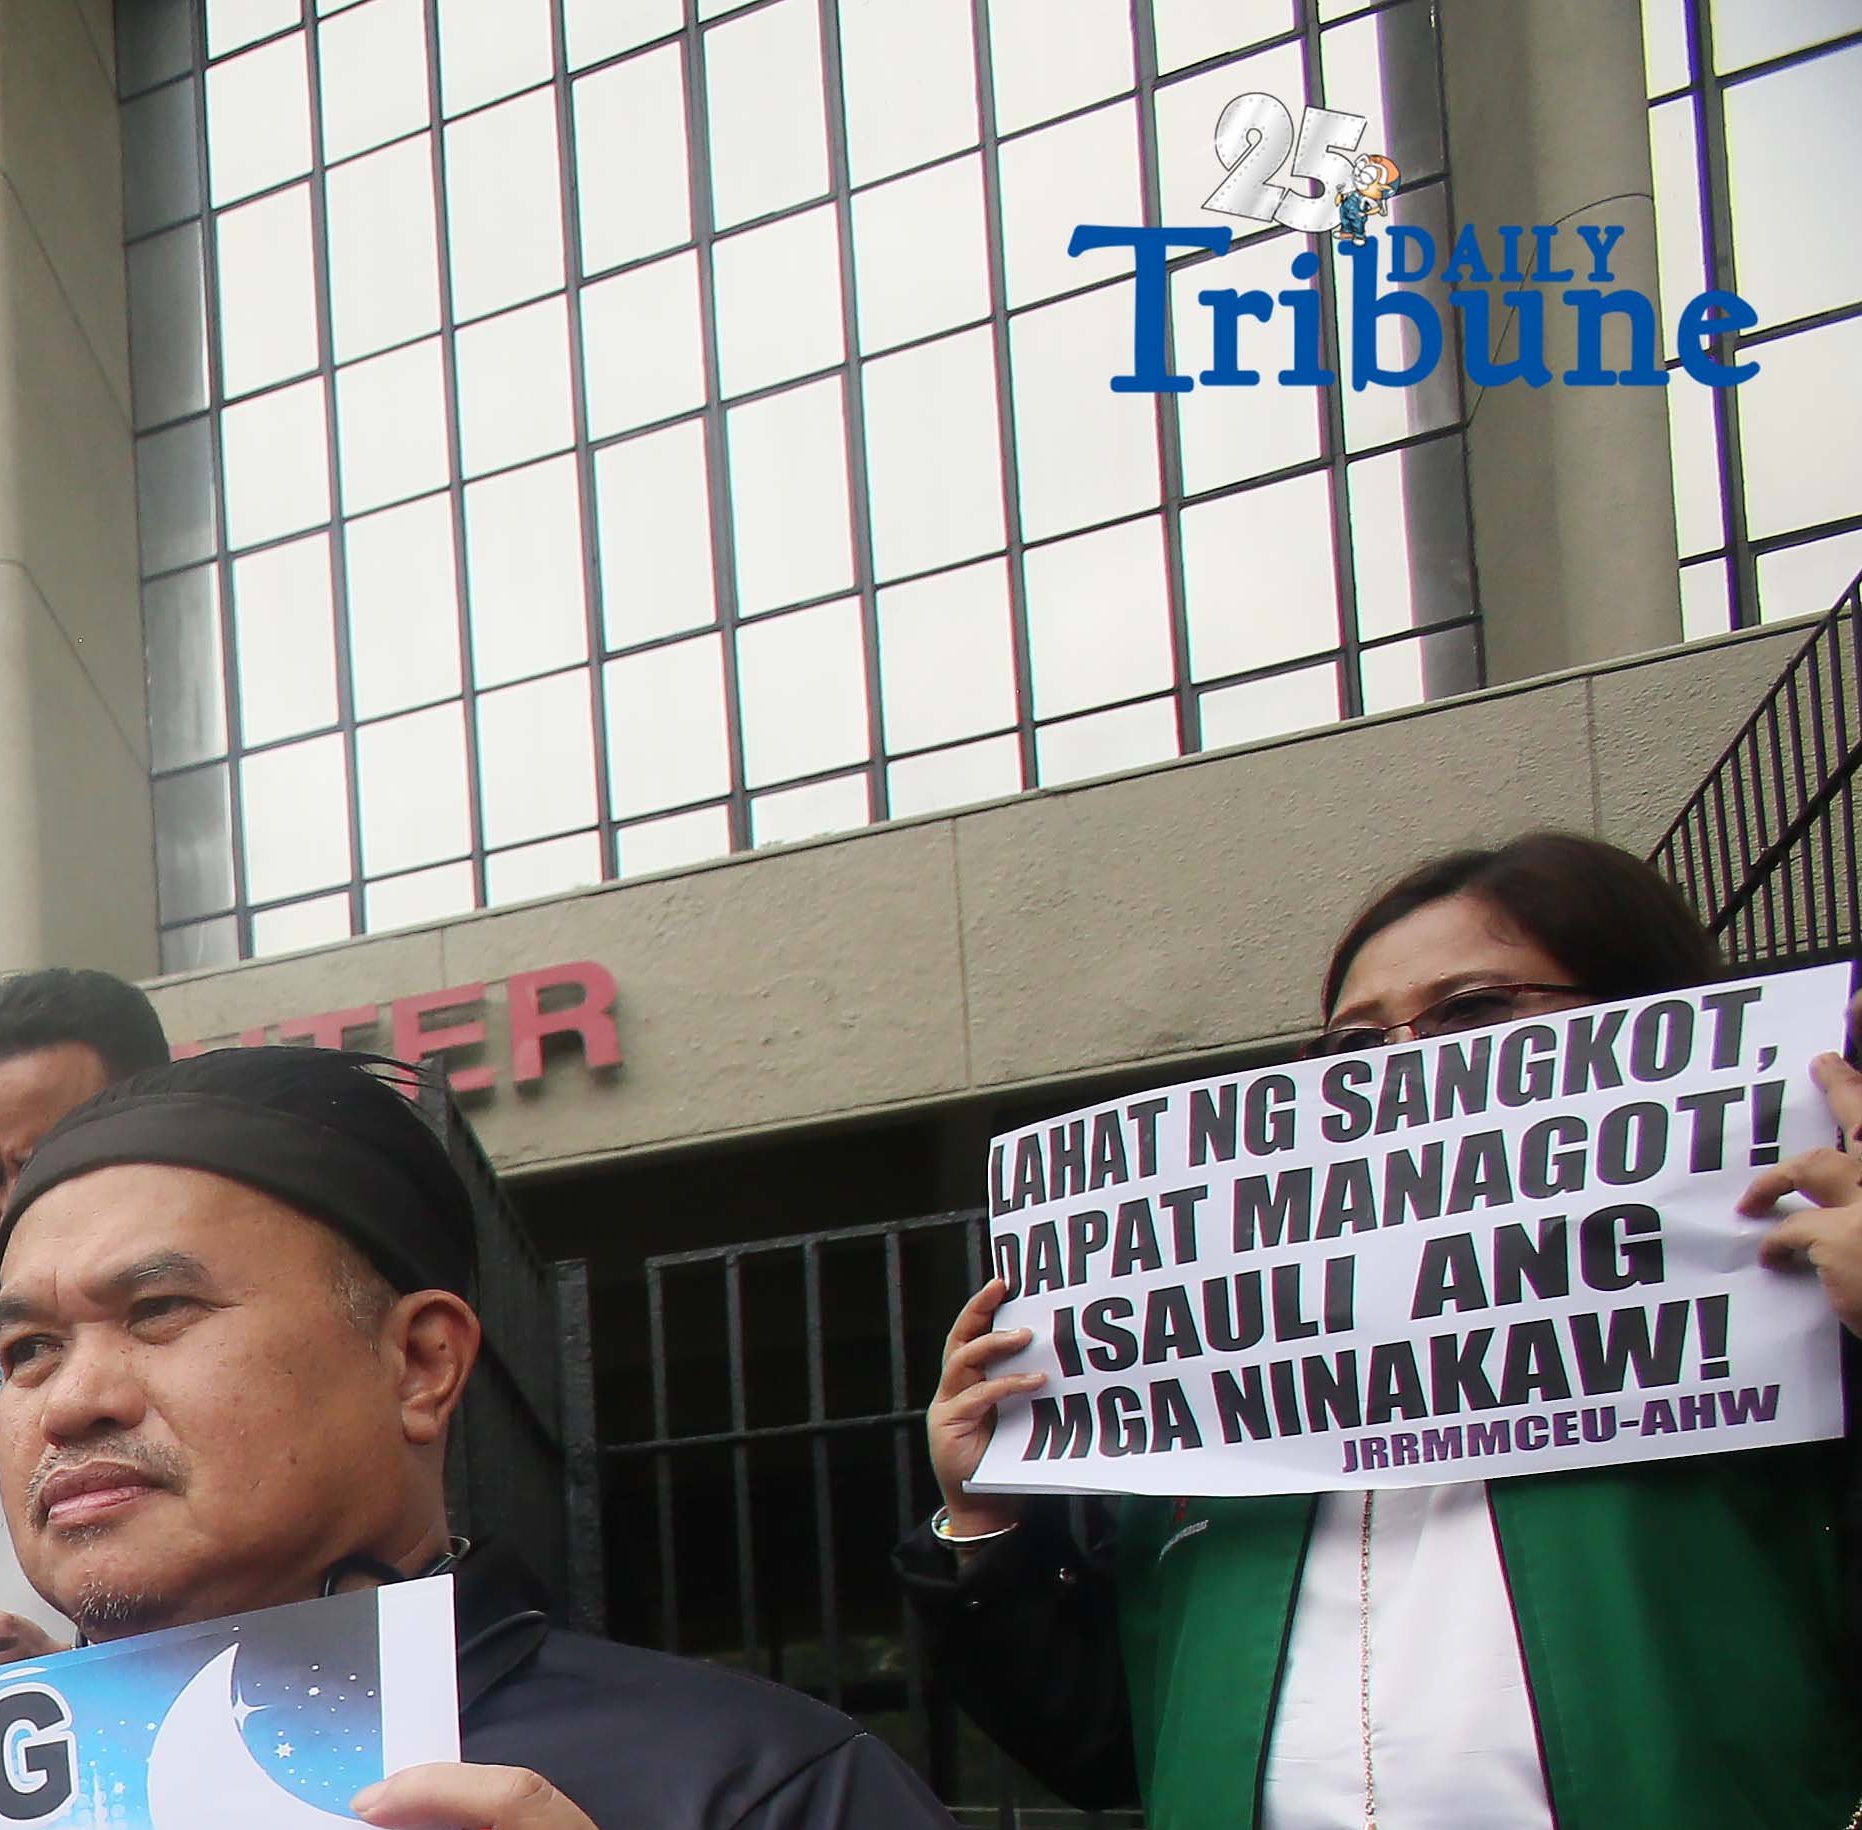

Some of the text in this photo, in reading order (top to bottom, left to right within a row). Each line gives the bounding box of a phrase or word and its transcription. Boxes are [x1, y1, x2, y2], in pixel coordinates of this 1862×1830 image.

[991, 986, 1780, 1218] LAHAT NG SANGKOT,
[993, 1080, 1785, 1303] DAPAT MANAGOT!
[1053, 1203, 1665, 1378] ISAULI ANG
[1022, 1294, 1731, 1463] MGA NINAKAW!
[1342, 1384, 1780, 1473] JRRMMCEU-AHW
